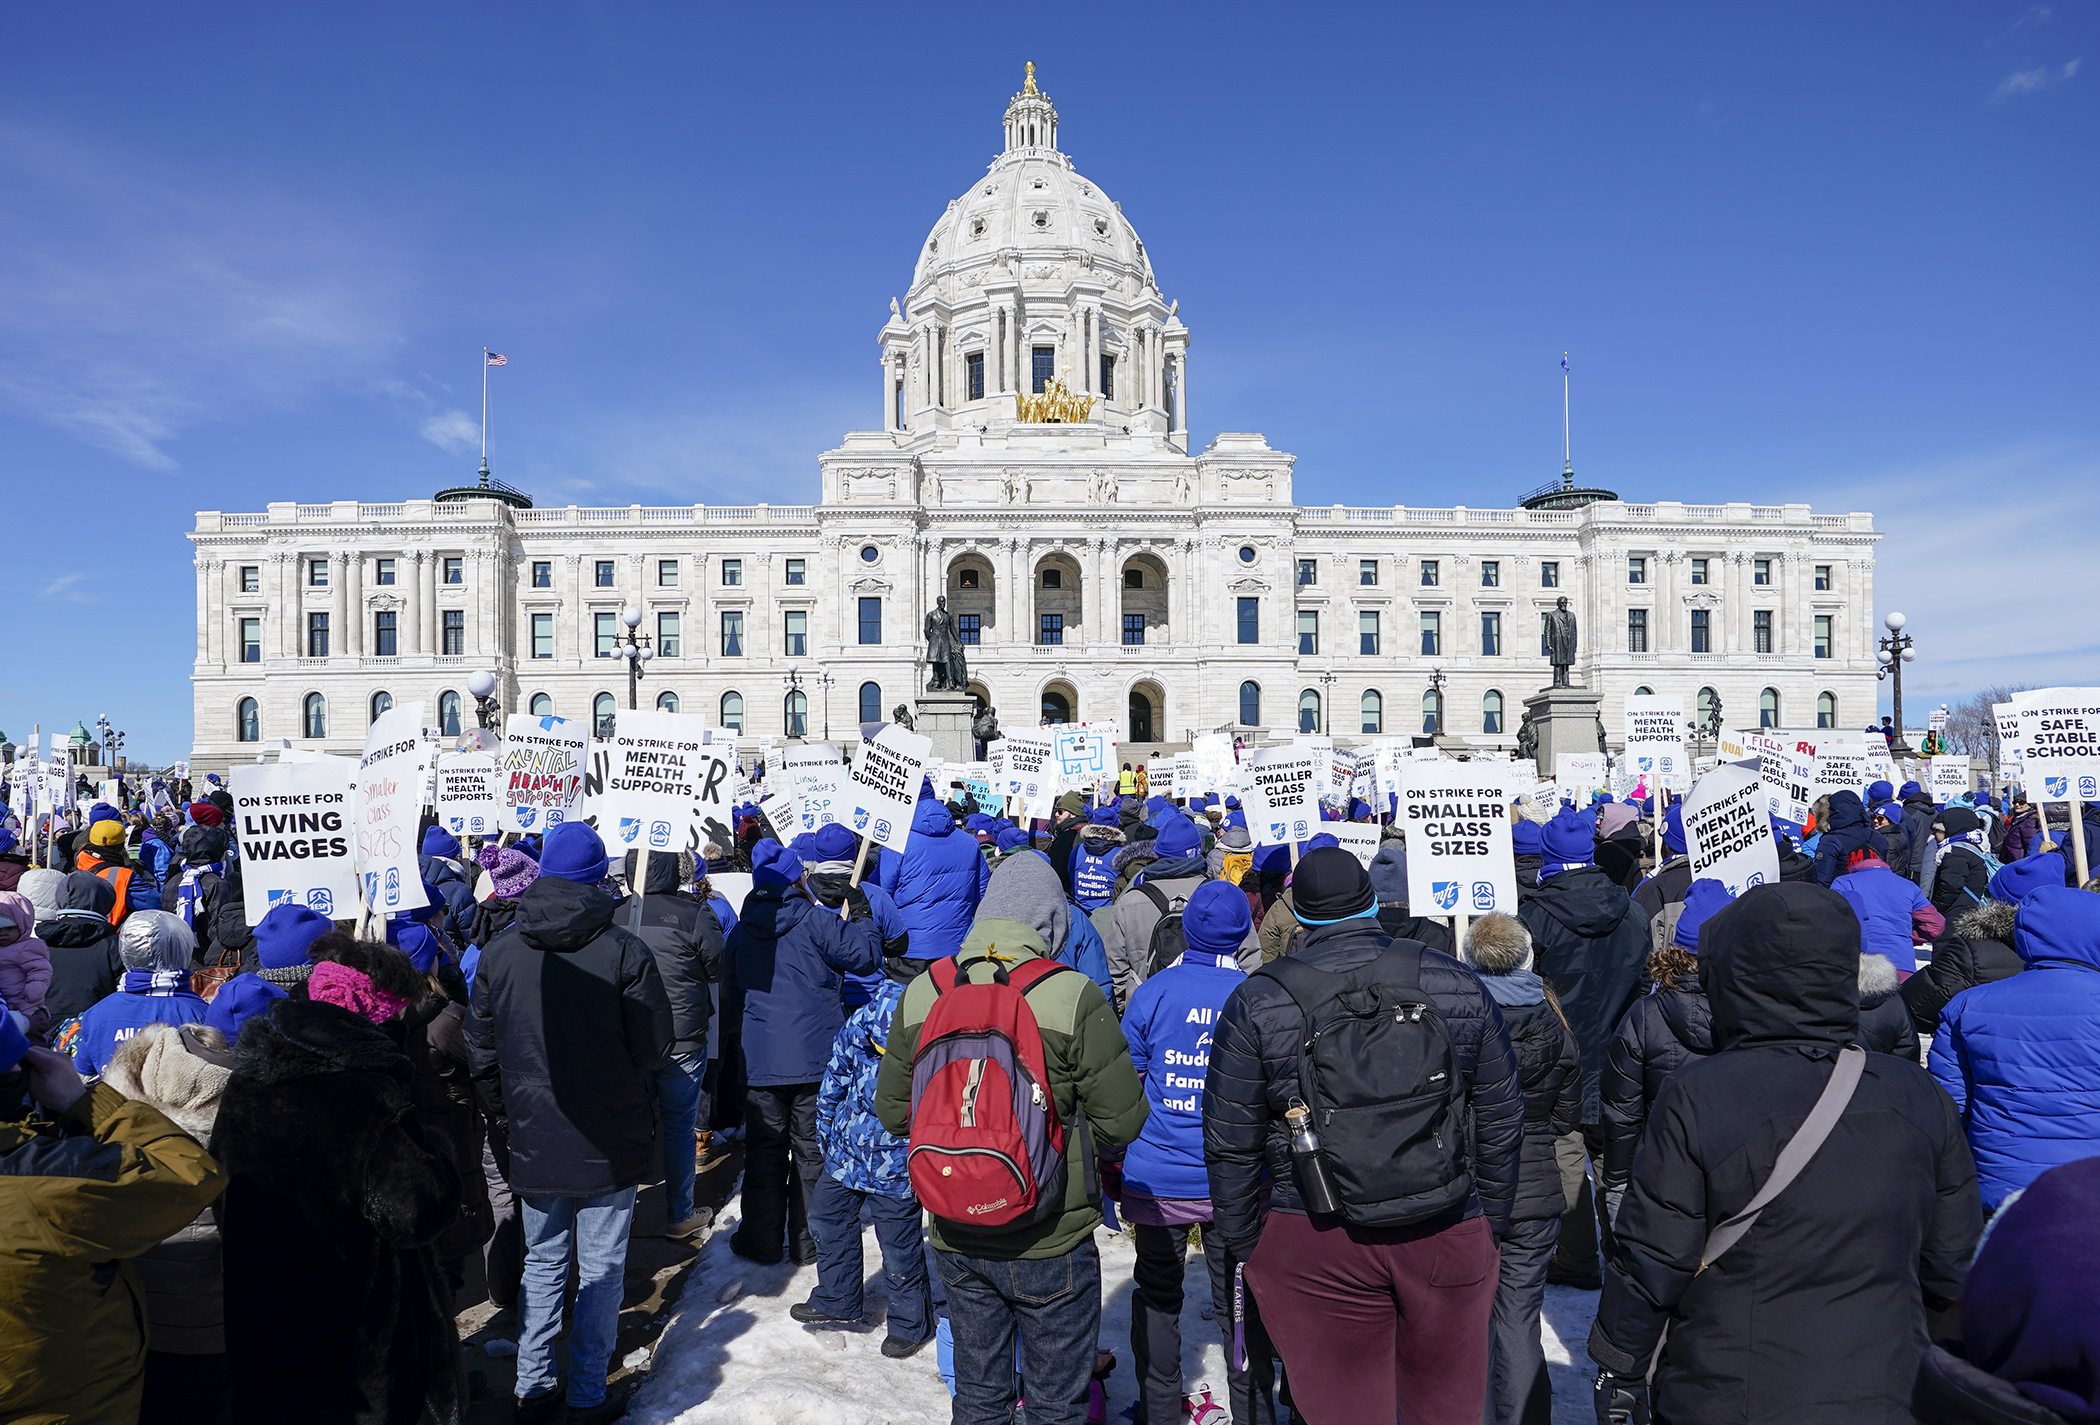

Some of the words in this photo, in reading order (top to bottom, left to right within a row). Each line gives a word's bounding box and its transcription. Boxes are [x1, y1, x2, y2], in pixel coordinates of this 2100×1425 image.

[2041, 708, 2079, 716] STRIKE
[1634, 718, 1674, 726] MENTAL
[2000, 721, 2018, 730] LIV
[2041, 719, 2088, 731] SAFE,
[1635, 726, 1674, 734] HEALTH
[526, 736, 562, 747] STRIKE
[564, 740, 584, 749] FOR
[618, 738, 634, 747] ON
[637, 739, 674, 750] STRIKE
[677, 742, 698, 751] FOR
[1752, 736, 1783, 752] FIELD
[2034, 732, 2097, 744] STABLE
[360, 756, 369, 769] ON
[369, 746, 394, 766] STRIKE
[395, 739, 415, 755] FOR
[863, 737, 875, 748] ON
[876, 743, 901, 760] STRIKE
[902, 756, 922, 768] FOR
[1007, 744, 1051, 757] SMALLER
[1759, 748, 1780, 758] STRIKE
[1782, 755, 1792, 764] FOR
[625, 751, 687, 767] MENTAL
[866, 751, 909, 779] MENTAL
[1012, 754, 1043, 765] CLASS
[1358, 760, 1375, 769] VING
[1571, 761, 1596, 769] RIGHT!
[1763, 757, 1784, 770] AFE,
[1013, 763, 1040, 773] SIZES
[1267, 762, 1294, 771] STRIKE
[1332, 765, 1352, 776] ALLER
[1826, 762, 1854, 770] SAFE,
[625, 765, 683, 781] HEALTH
[864, 763, 906, 790] HEALTH
[1255, 770, 1312, 786] SMALLER
[1761, 766, 1787, 780] ABLE
[1820, 770, 1858, 778] STABLE
[610, 778, 692, 796] SUPPORTS
[1762, 774, 1790, 790] HOOLS
[1814, 777, 1862, 785] SCHOOLS
[363, 780, 399, 804] Smaller
[851, 771, 913, 805] SUPPORTS
[1240, 785, 1250, 793] ON
[1265, 783, 1305, 796] CLASS
[1407, 790, 1426, 798] ON
[1429, 789, 1473, 798] STRIKE
[1478, 789, 1502, 797] FOR
[238, 797, 260, 807] ON
[264, 794, 311, 806] STRIKE
[315, 794, 343, 803] FOR
[440, 793, 493, 801] SUPPORTS
[1268, 795, 1304, 808] SIZES
[1535, 791, 1555, 800] ALLER
[804, 799, 831, 812] ESP
[1686, 813, 1698, 827] ON
[1700, 794, 1738, 818] STRIKE
[1739, 782, 1760, 799] FOR
[774, 807, 792, 820] MENT
[1408, 804, 1504, 819] SMALLER
[244, 811, 342, 835] LIVING
[776, 820, 794, 833] SUPP
[1695, 802, 1755, 839] MENTAL
[1425, 822, 1492, 837] CLASS
[1700, 815, 1756, 854] HEALTH
[243, 837, 348, 861] WAGES
[1430, 841, 1489, 856] SIZES
[1694, 824, 1769, 873] SUPPORTS
[1084, 856, 1094, 864] All
[1078, 872, 1108, 882] Students,
[1433, 881, 1463, 906] mft
[1186, 1008, 1212, 1025] All
[114, 1028, 134, 1041] All
[1196, 1032, 1214, 1050] for
[1164, 1049, 1210, 1066] Stude
[1163, 1095, 1196, 1112] and
[975, 1198, 1007, 1211] Columbia
[1234, 1285, 1242, 1323] LAKERS
